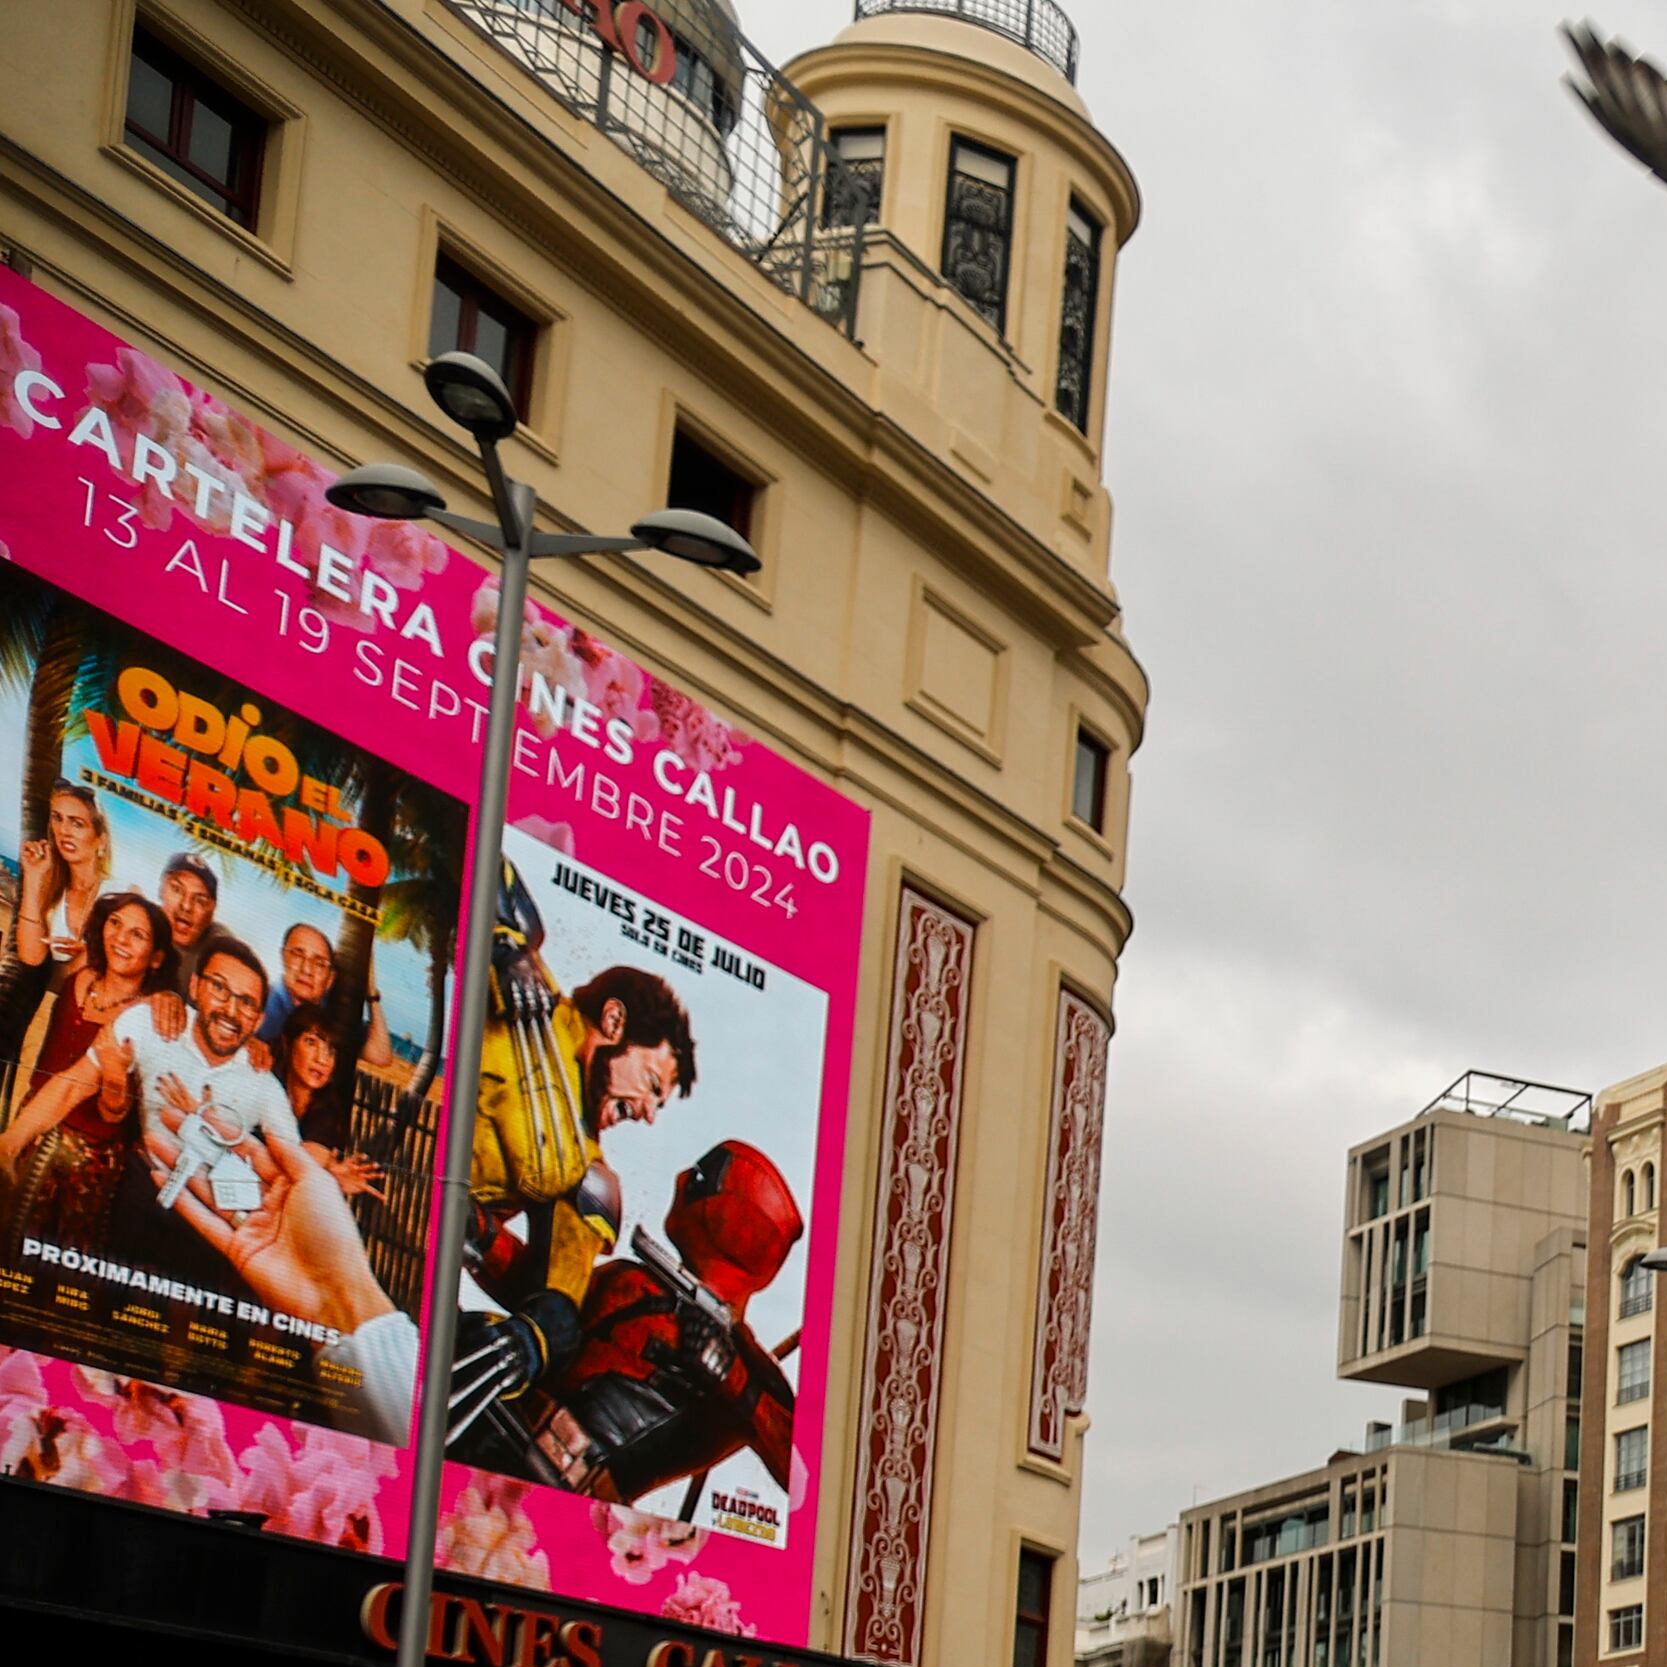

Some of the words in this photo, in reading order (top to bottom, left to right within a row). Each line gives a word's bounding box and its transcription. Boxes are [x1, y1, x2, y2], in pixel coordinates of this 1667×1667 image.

[13, 369, 444, 658] CARTELERA
[652, 750, 839, 885] CALLAO
[76, 476, 140, 551] 13
[164, 540, 250, 616] AL
[274, 589, 330, 655] 19
[352, 638, 684, 859] SEPTEMBRE
[699, 835, 799, 919] 2024
[81, 767, 95, 783] 3
[82, 709, 390, 888] VERANO
[301, 774, 352, 823] EL
[551, 862, 636, 925] JUEVES
[641, 909, 673, 942] 25
[677, 926, 706, 960] DE
[710, 945, 767, 991] JULIO
[653, 939, 668, 958] EN
[22, 1237, 236, 1315] PRÓXIMAMENTE
[236, 1304, 270, 1327] EN
[272, 1312, 342, 1347] CINES
[711, 1491, 780, 1527] DEADPOOL
